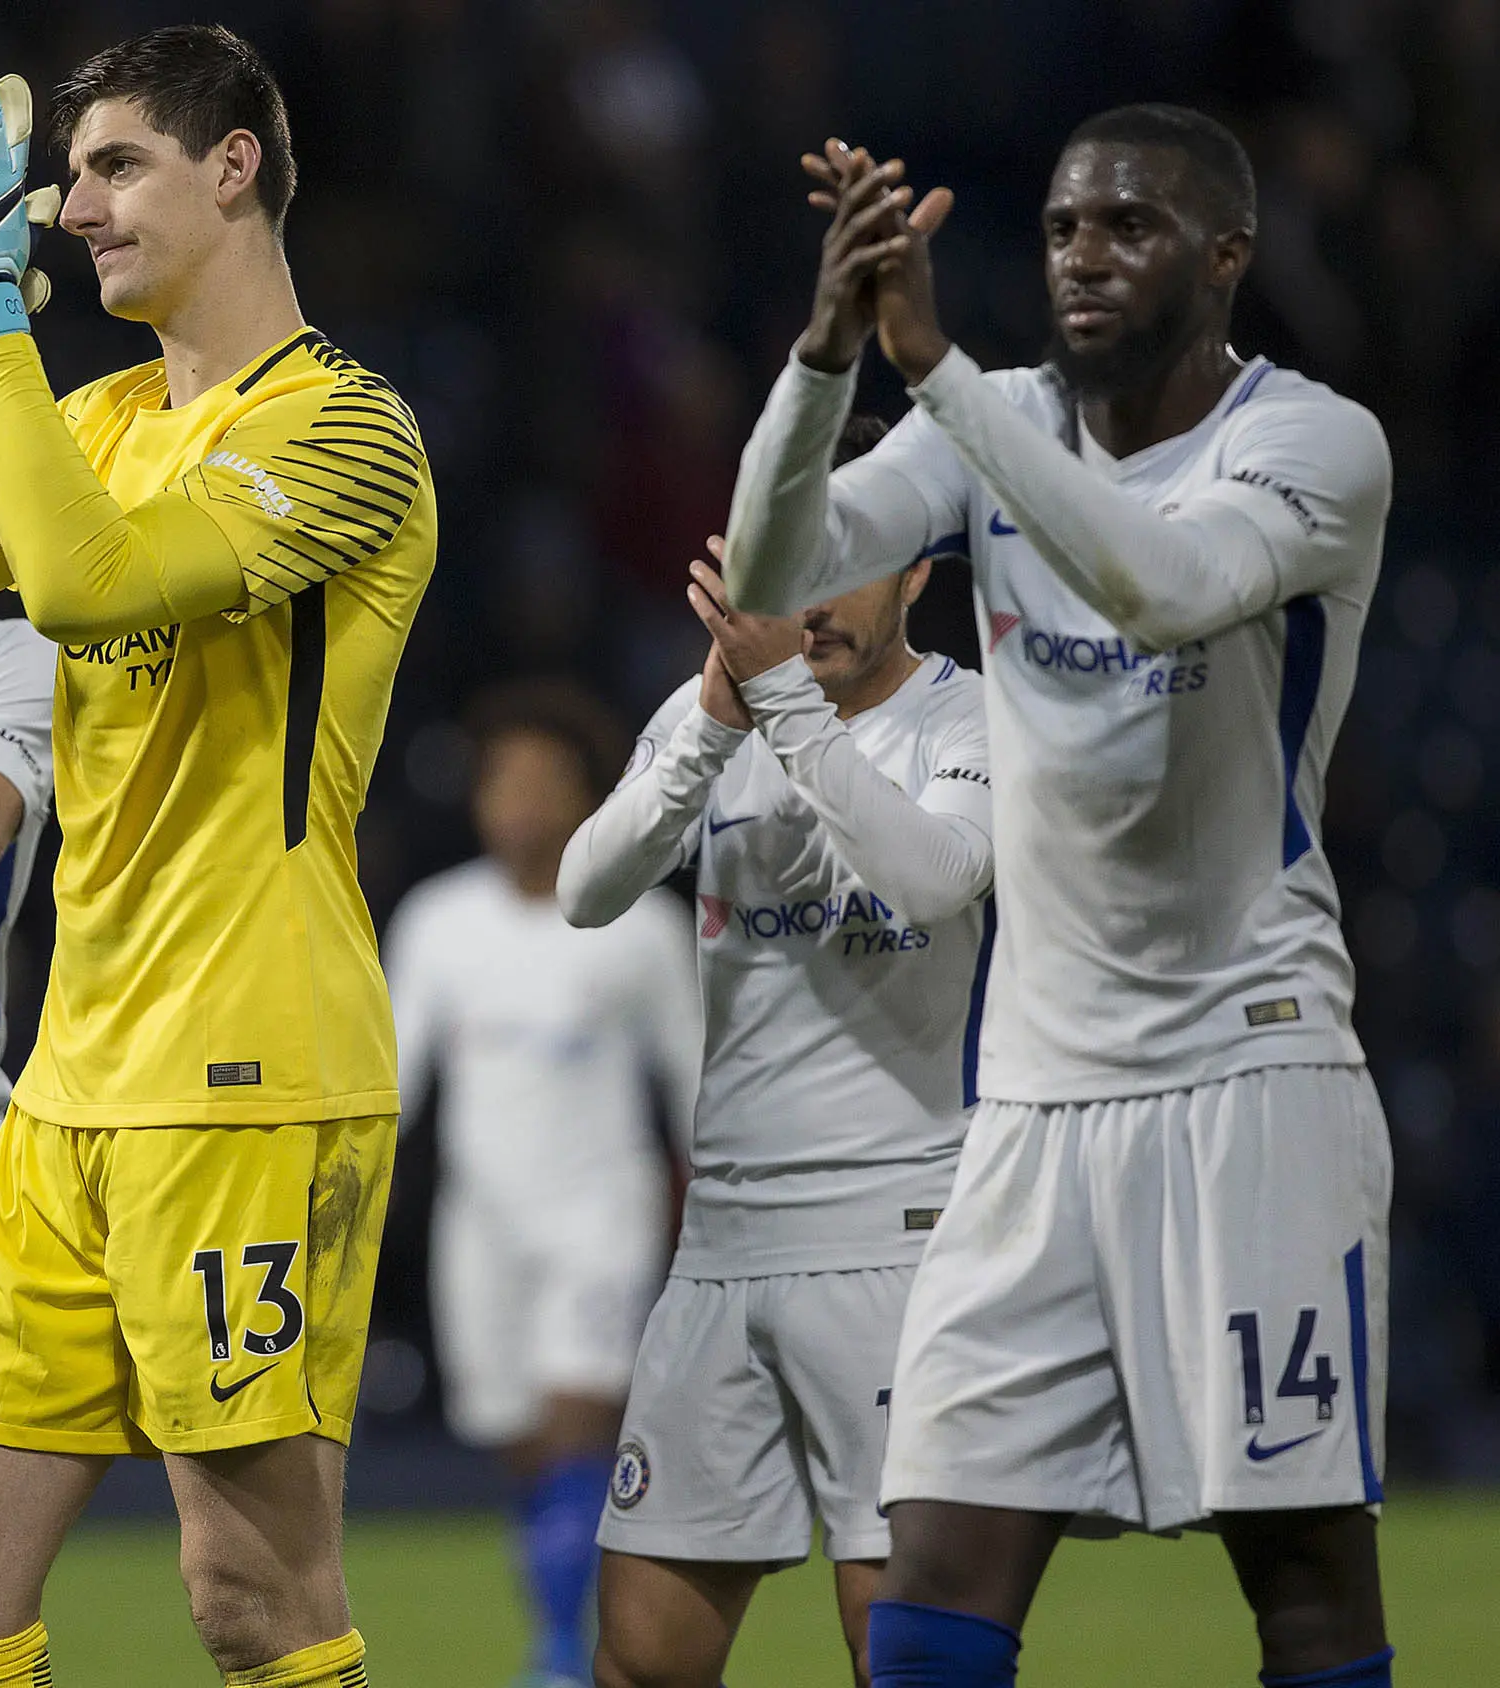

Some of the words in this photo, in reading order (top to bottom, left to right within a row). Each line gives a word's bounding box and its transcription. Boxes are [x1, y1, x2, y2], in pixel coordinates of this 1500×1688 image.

[208, 451, 293, 517] ALLIANCE
[843, 927, 931, 955] TYRES
[191, 1240, 306, 1362] 13
[1226, 1307, 1340, 1425] 14
